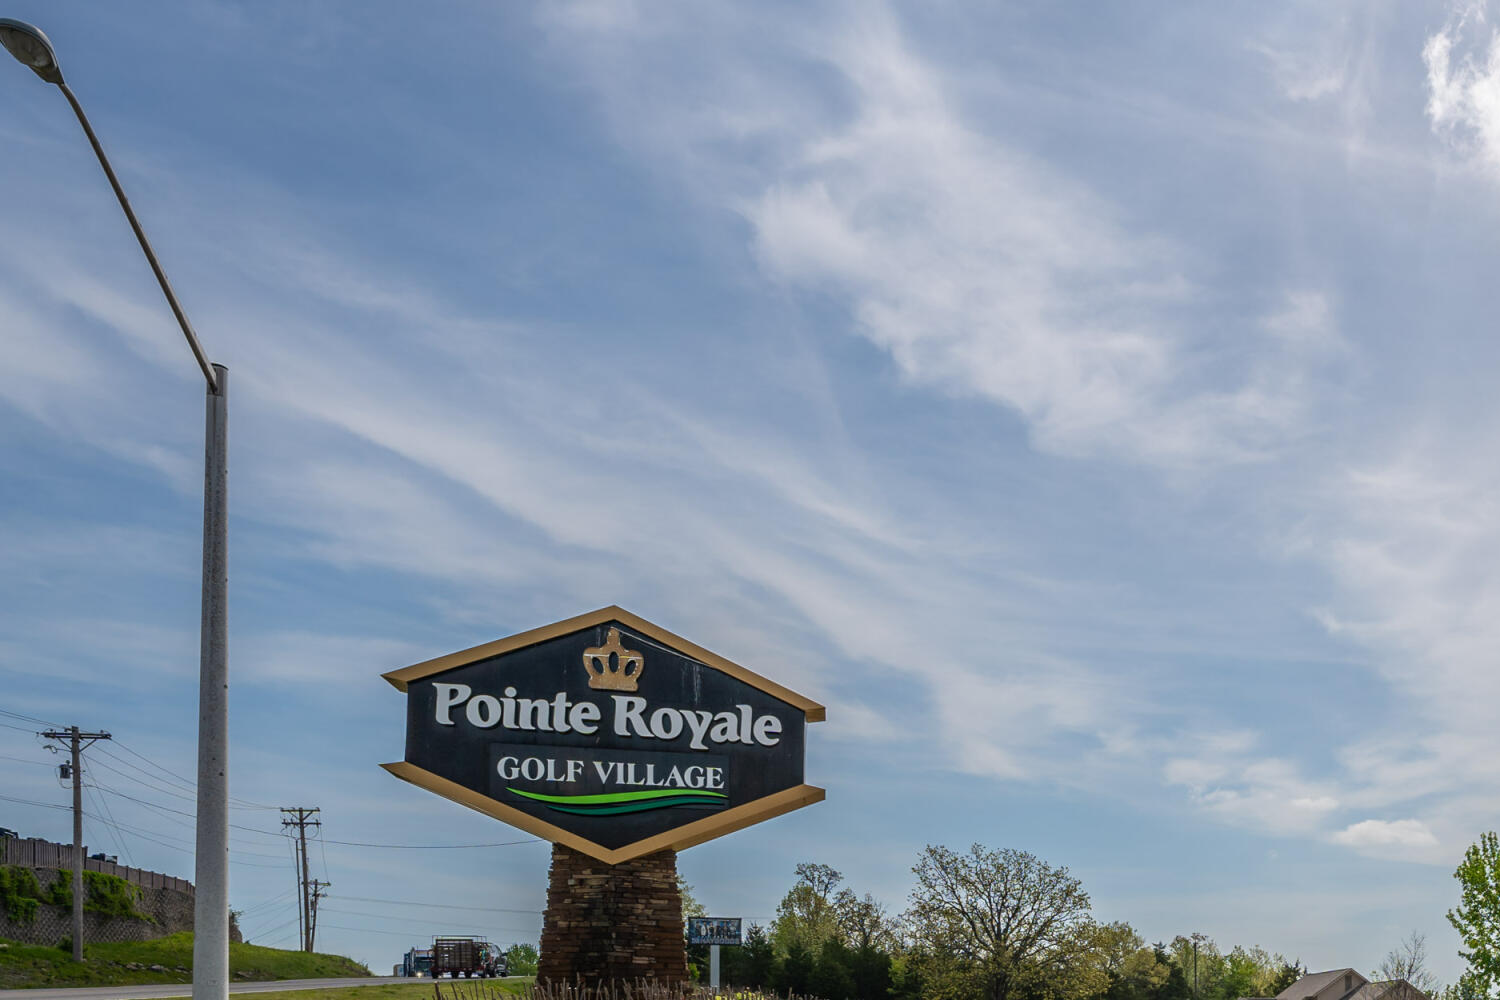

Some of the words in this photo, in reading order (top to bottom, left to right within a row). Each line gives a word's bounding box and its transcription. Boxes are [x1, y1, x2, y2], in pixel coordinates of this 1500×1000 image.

[432, 682, 601, 734] Pointe
[611, 694, 783, 750] Royale
[496, 756, 585, 783] GOLF
[593, 760, 725, 790] VILLAGE
